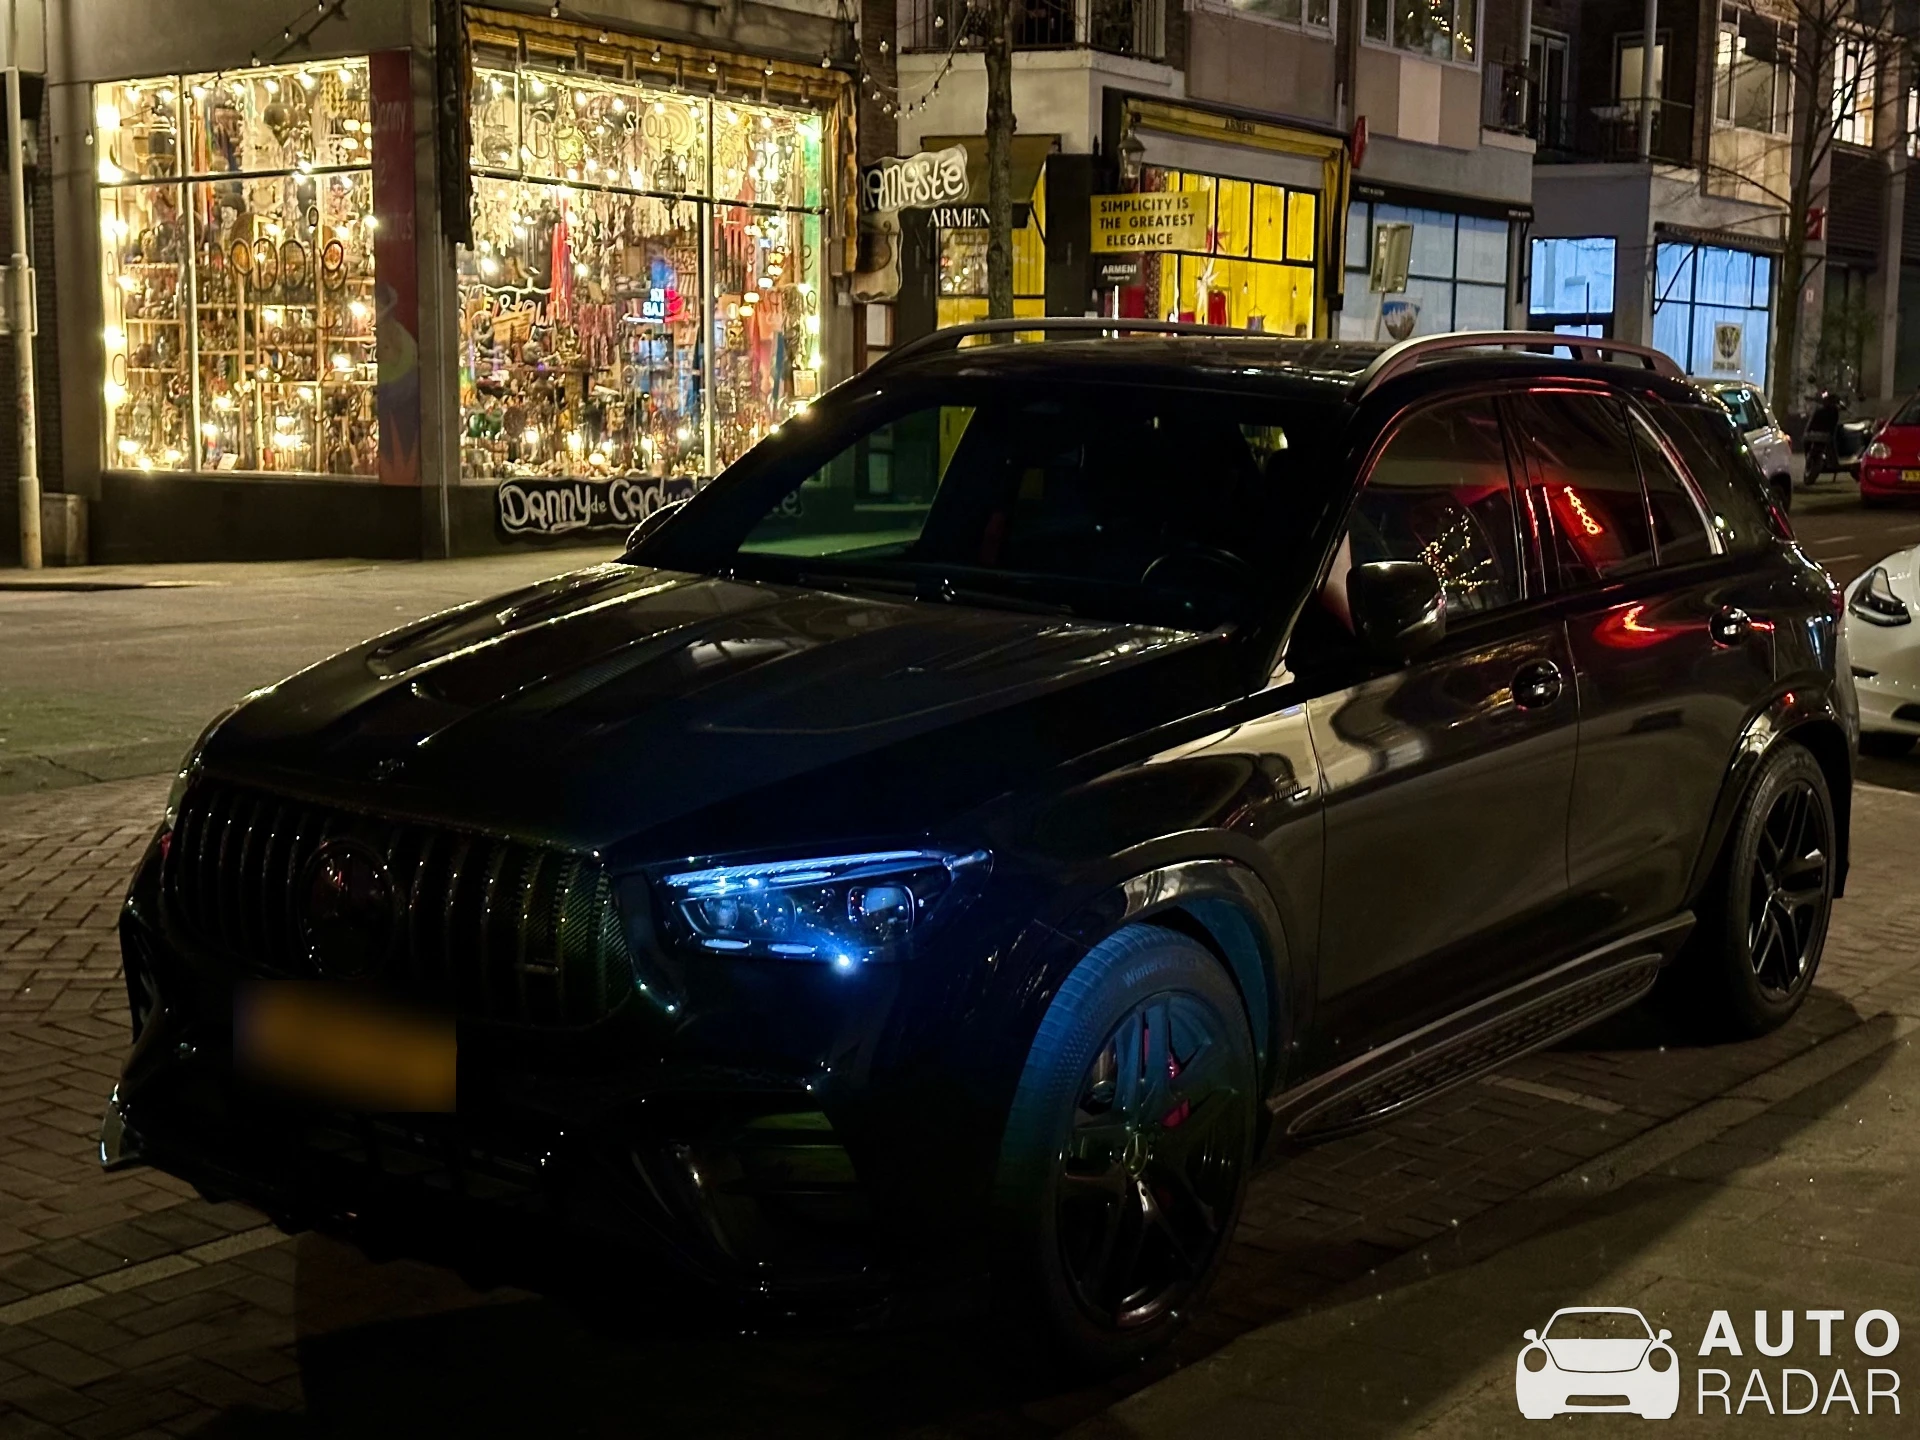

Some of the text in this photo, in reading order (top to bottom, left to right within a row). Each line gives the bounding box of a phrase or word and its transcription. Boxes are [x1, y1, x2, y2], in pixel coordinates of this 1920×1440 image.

[1100, 197, 1189, 213] SIMPLICITY IS
[927, 207, 991, 228] ARMEN
[1099, 213, 1195, 230] THE GREATEST
[1106, 233, 1173, 247] ELEGANCE
[1101, 263, 1137, 275] ARMENI
[501, 484, 591, 531] Danny
[591, 494, 608, 513] de
